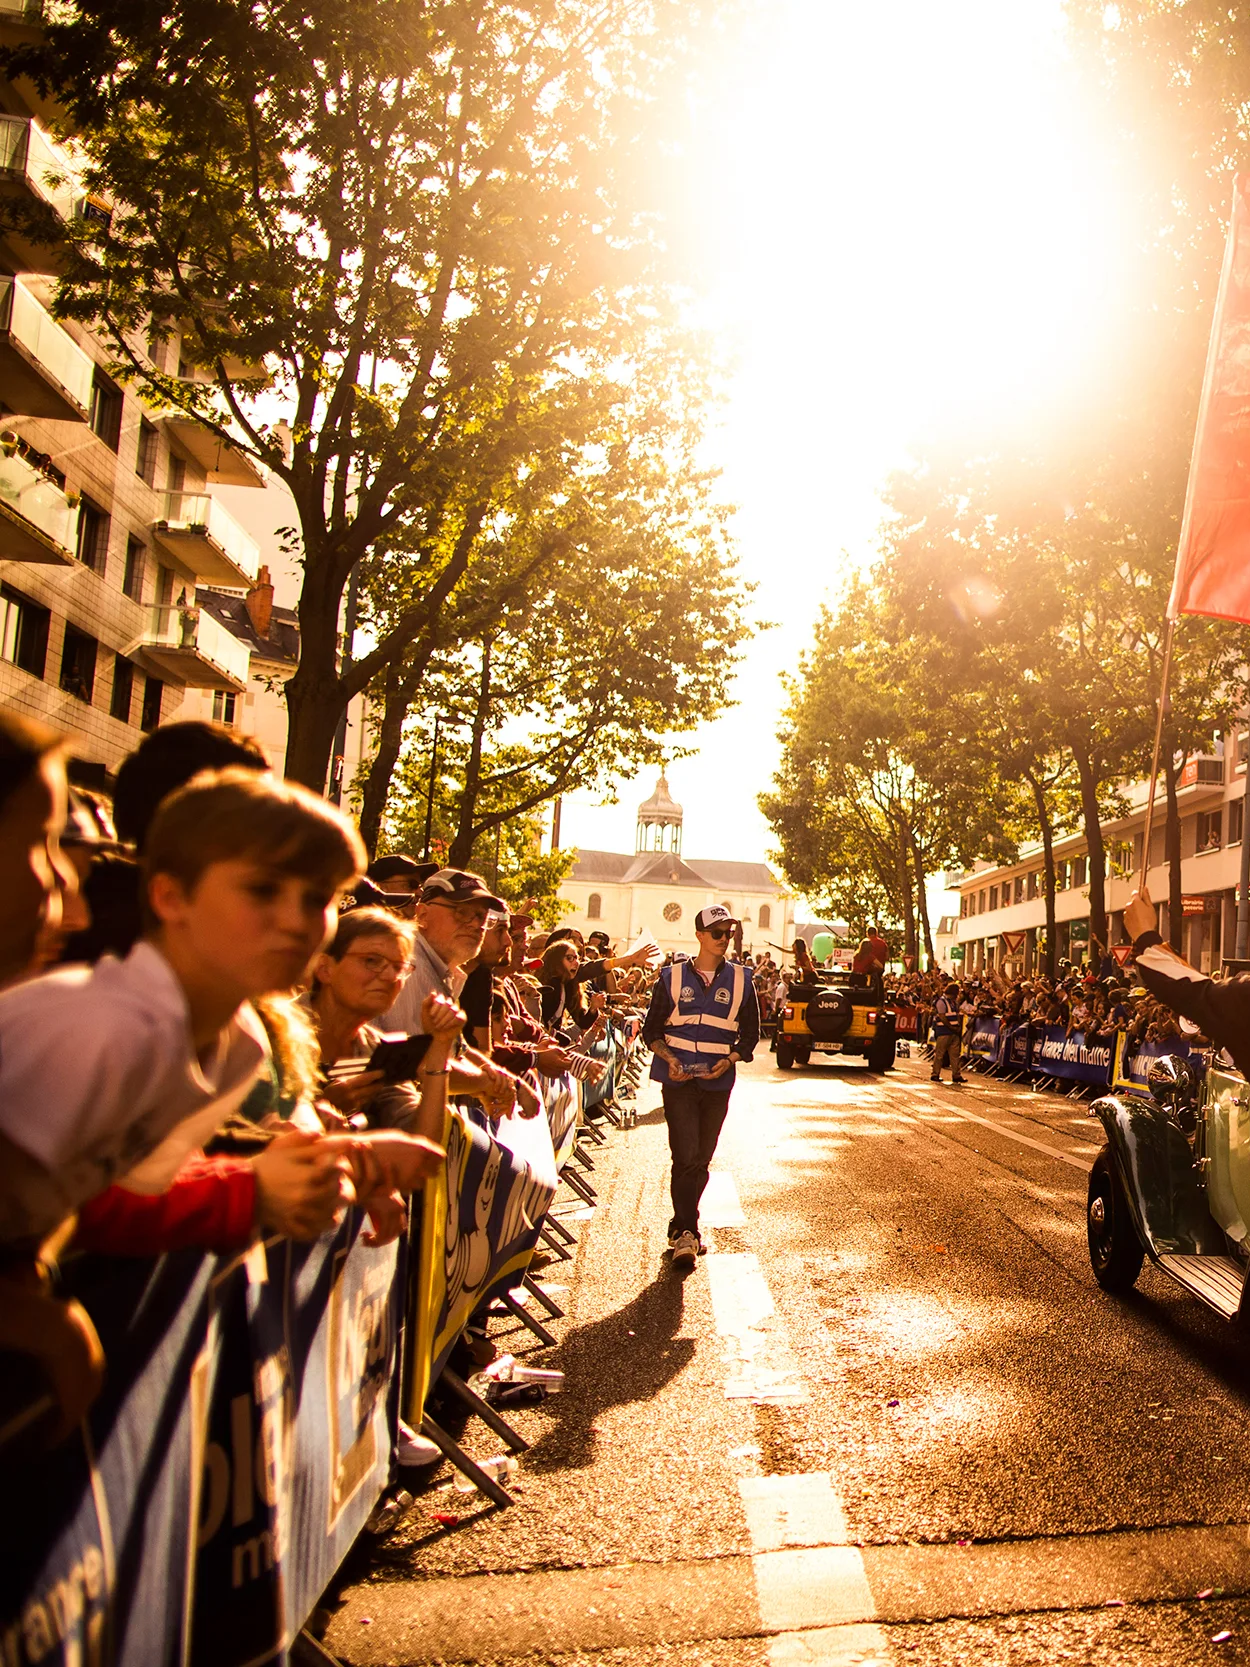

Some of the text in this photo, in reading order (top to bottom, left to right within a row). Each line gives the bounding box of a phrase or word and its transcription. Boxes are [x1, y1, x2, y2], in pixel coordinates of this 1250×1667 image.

[818, 1000, 839, 1009] Jeep
[1042, 1035, 1064, 1060] france
[1062, 1038, 1078, 1062] bleu
[1079, 1044, 1110, 1067] maine
